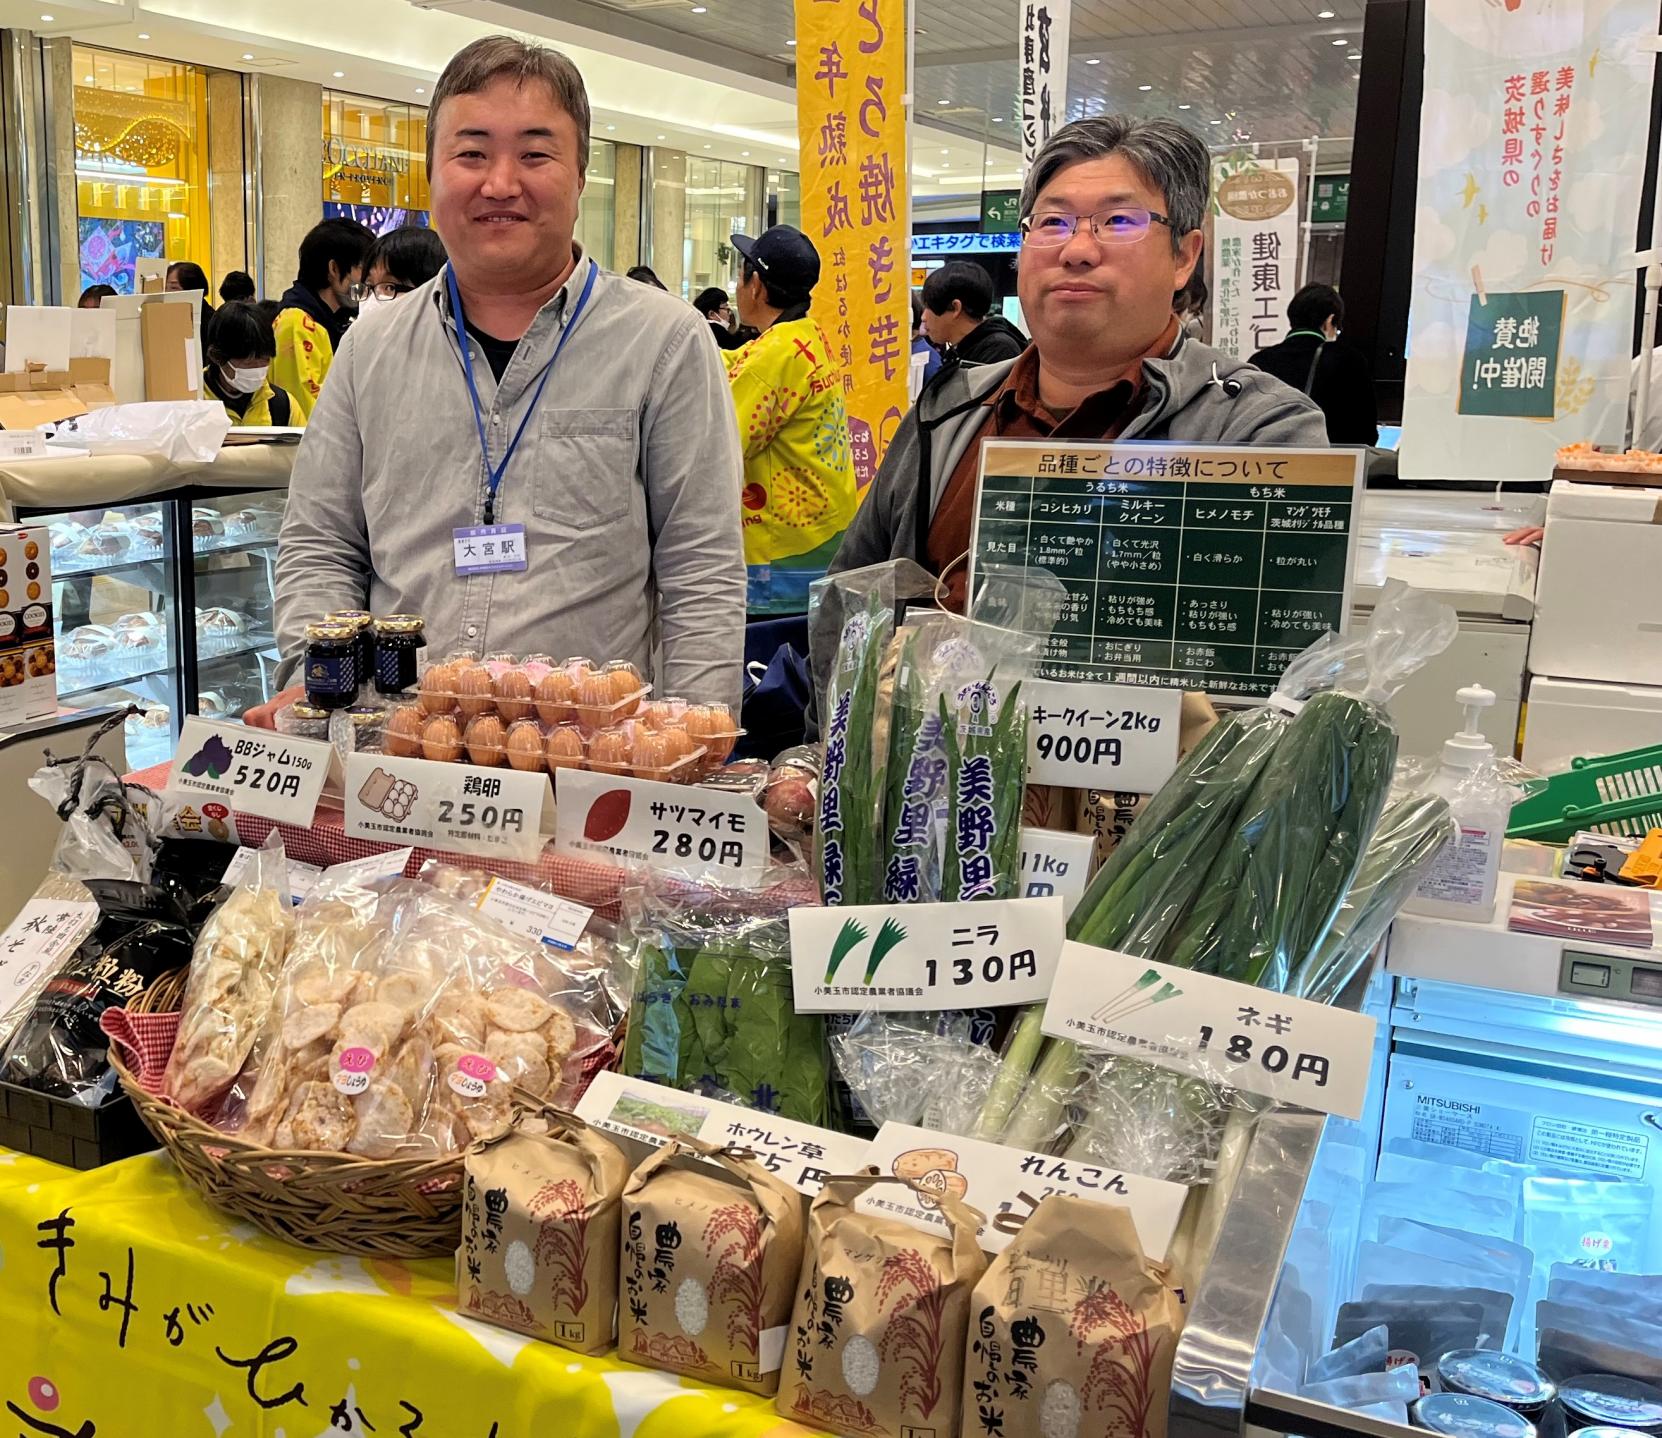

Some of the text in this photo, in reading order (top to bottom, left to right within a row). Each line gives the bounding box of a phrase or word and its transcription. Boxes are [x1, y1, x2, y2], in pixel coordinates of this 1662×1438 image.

[1037, 453, 1289, 480] 品種ごとの特徴について
[1085, 482, 1129, 494] うるち米
[1249, 486, 1292, 499] もち米
[995, 501, 1016, 512] 米種
[1040, 502, 1093, 515] コシヒカリ
[1121, 499, 1167, 511] ミルキー
[1195, 508, 1256, 522] ヒメノモチ
[1119, 512, 1166, 525] クイーン
[464, 540, 515, 558] 大宮駅
[986, 542, 1017, 554] 見た目
[1189, 600, 1229, 610] あっさり
[1036, 734, 1122, 767] 900円
[233, 766, 301, 803] 520円
[463, 775, 501, 802] 鶏卵
[437, 800, 525, 834] 250円
[650, 801, 746, 834] サツマイモ
[652, 829, 744, 868] 280円
[951, 924, 999, 946] ニラ
[925, 948, 1037, 987] 130円
[1236, 1006, 1293, 1036] ネギ
[1199, 1025, 1330, 1087] 180円
[1416, 1095, 1481, 1114] MITSUBISHI
[726, 1122, 826, 1160] ホウレン草
[1020, 1155, 1129, 1195] れんこん
